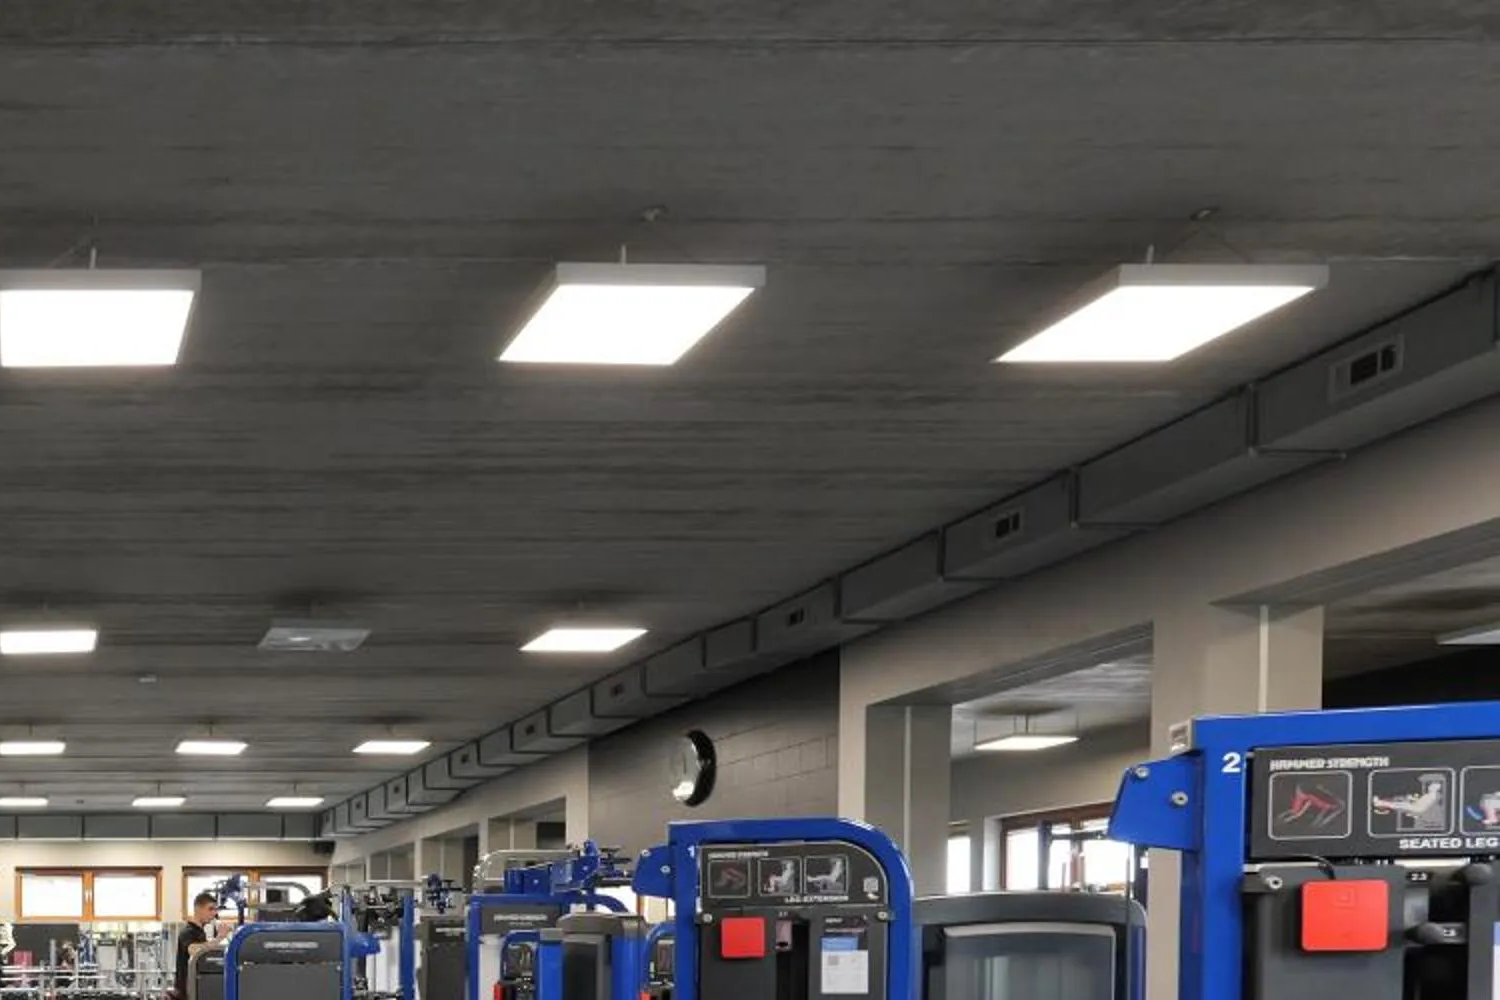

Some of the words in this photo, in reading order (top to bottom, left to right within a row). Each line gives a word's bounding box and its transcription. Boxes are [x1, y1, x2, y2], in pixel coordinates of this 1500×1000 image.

[1222, 752, 1241, 773] 2
[1269, 758, 1325, 771] HAMMER
[1326, 756, 1389, 768] STRENGTH
[1399, 838, 1461, 849] SEATED
[1465, 837, 1499, 848] LEG
